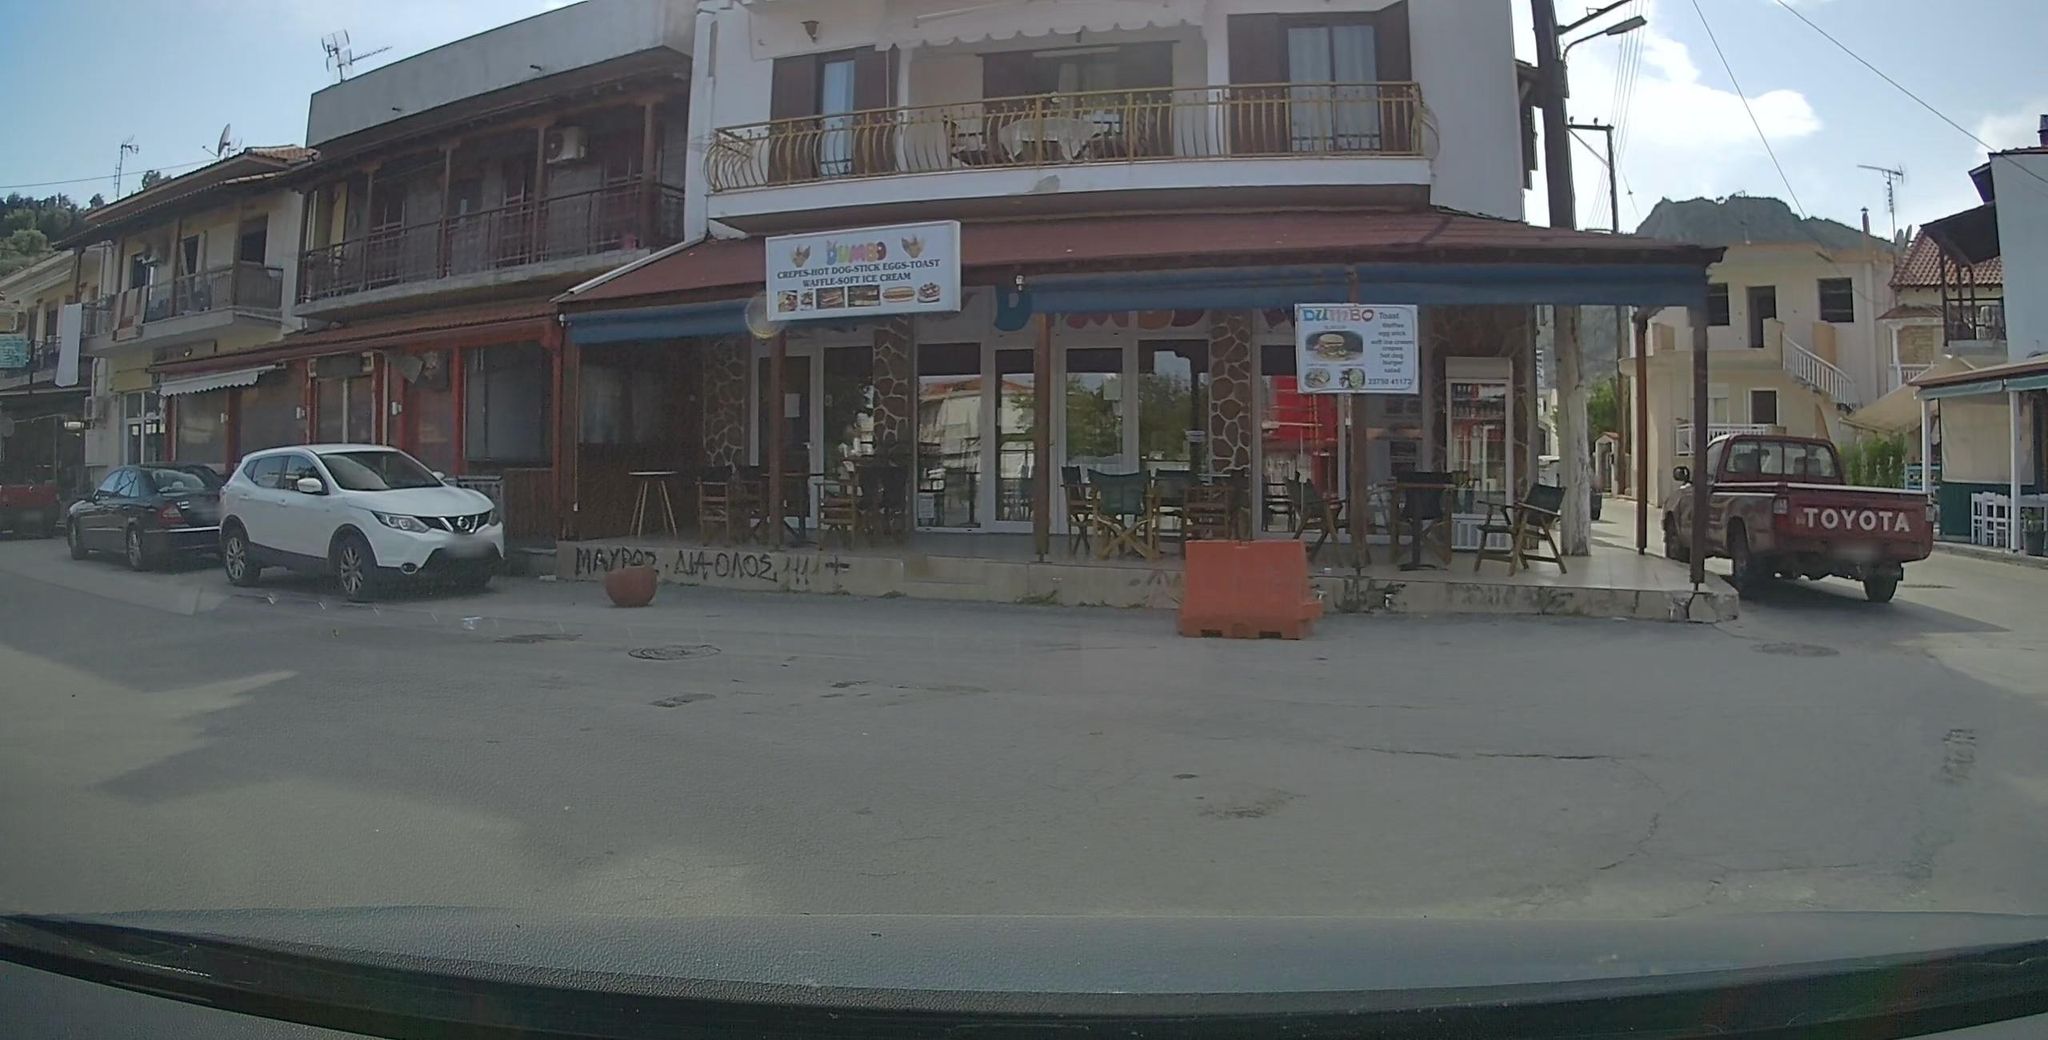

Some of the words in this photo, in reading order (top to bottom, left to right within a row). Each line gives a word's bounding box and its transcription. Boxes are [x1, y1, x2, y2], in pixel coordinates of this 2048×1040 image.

[826, 240, 887, 265] DUMBO
[803, 276, 860, 288] WAFFLE-SOFT
[863, 274, 878, 283] ICE
[880, 272, 911, 282] CREAM
[1803, 507, 1911, 532] TOYOTA
